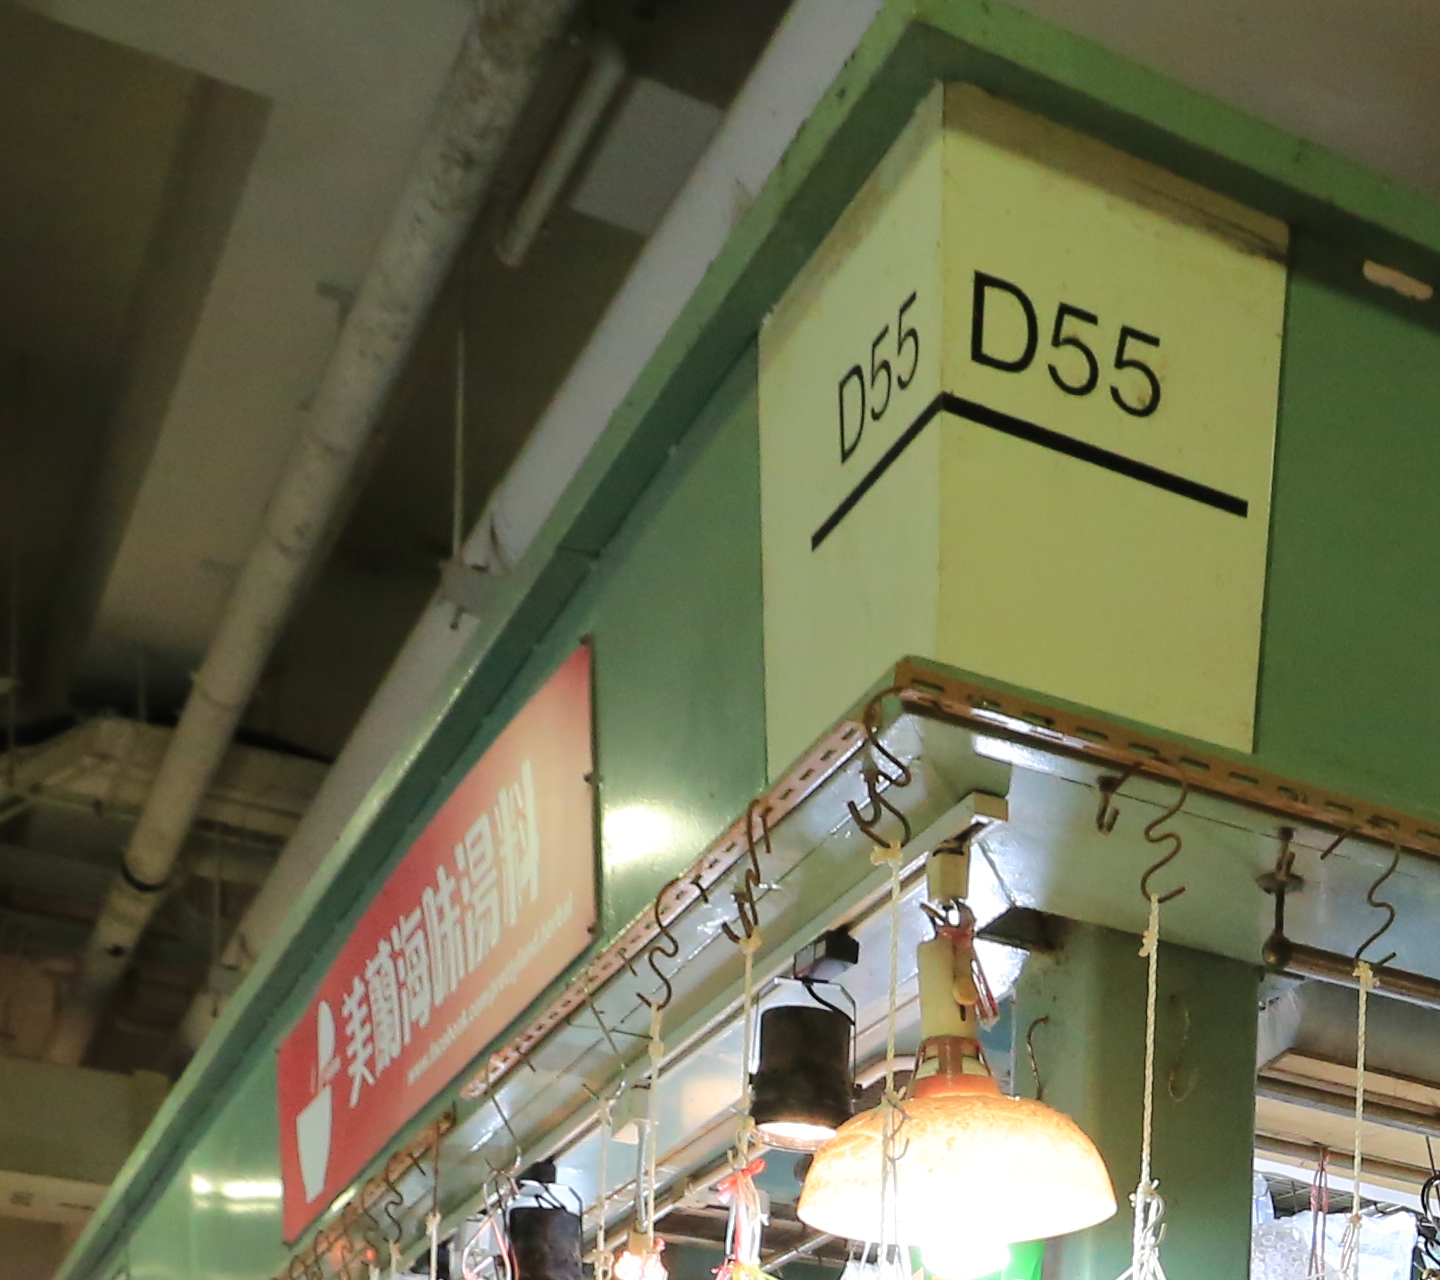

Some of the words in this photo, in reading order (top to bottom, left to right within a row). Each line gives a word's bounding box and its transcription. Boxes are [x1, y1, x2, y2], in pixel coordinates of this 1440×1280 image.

[837, 290, 921, 465] D55
[971, 270, 1162, 419] D55
[342, 758, 540, 1108] 美蘭海味湯料
